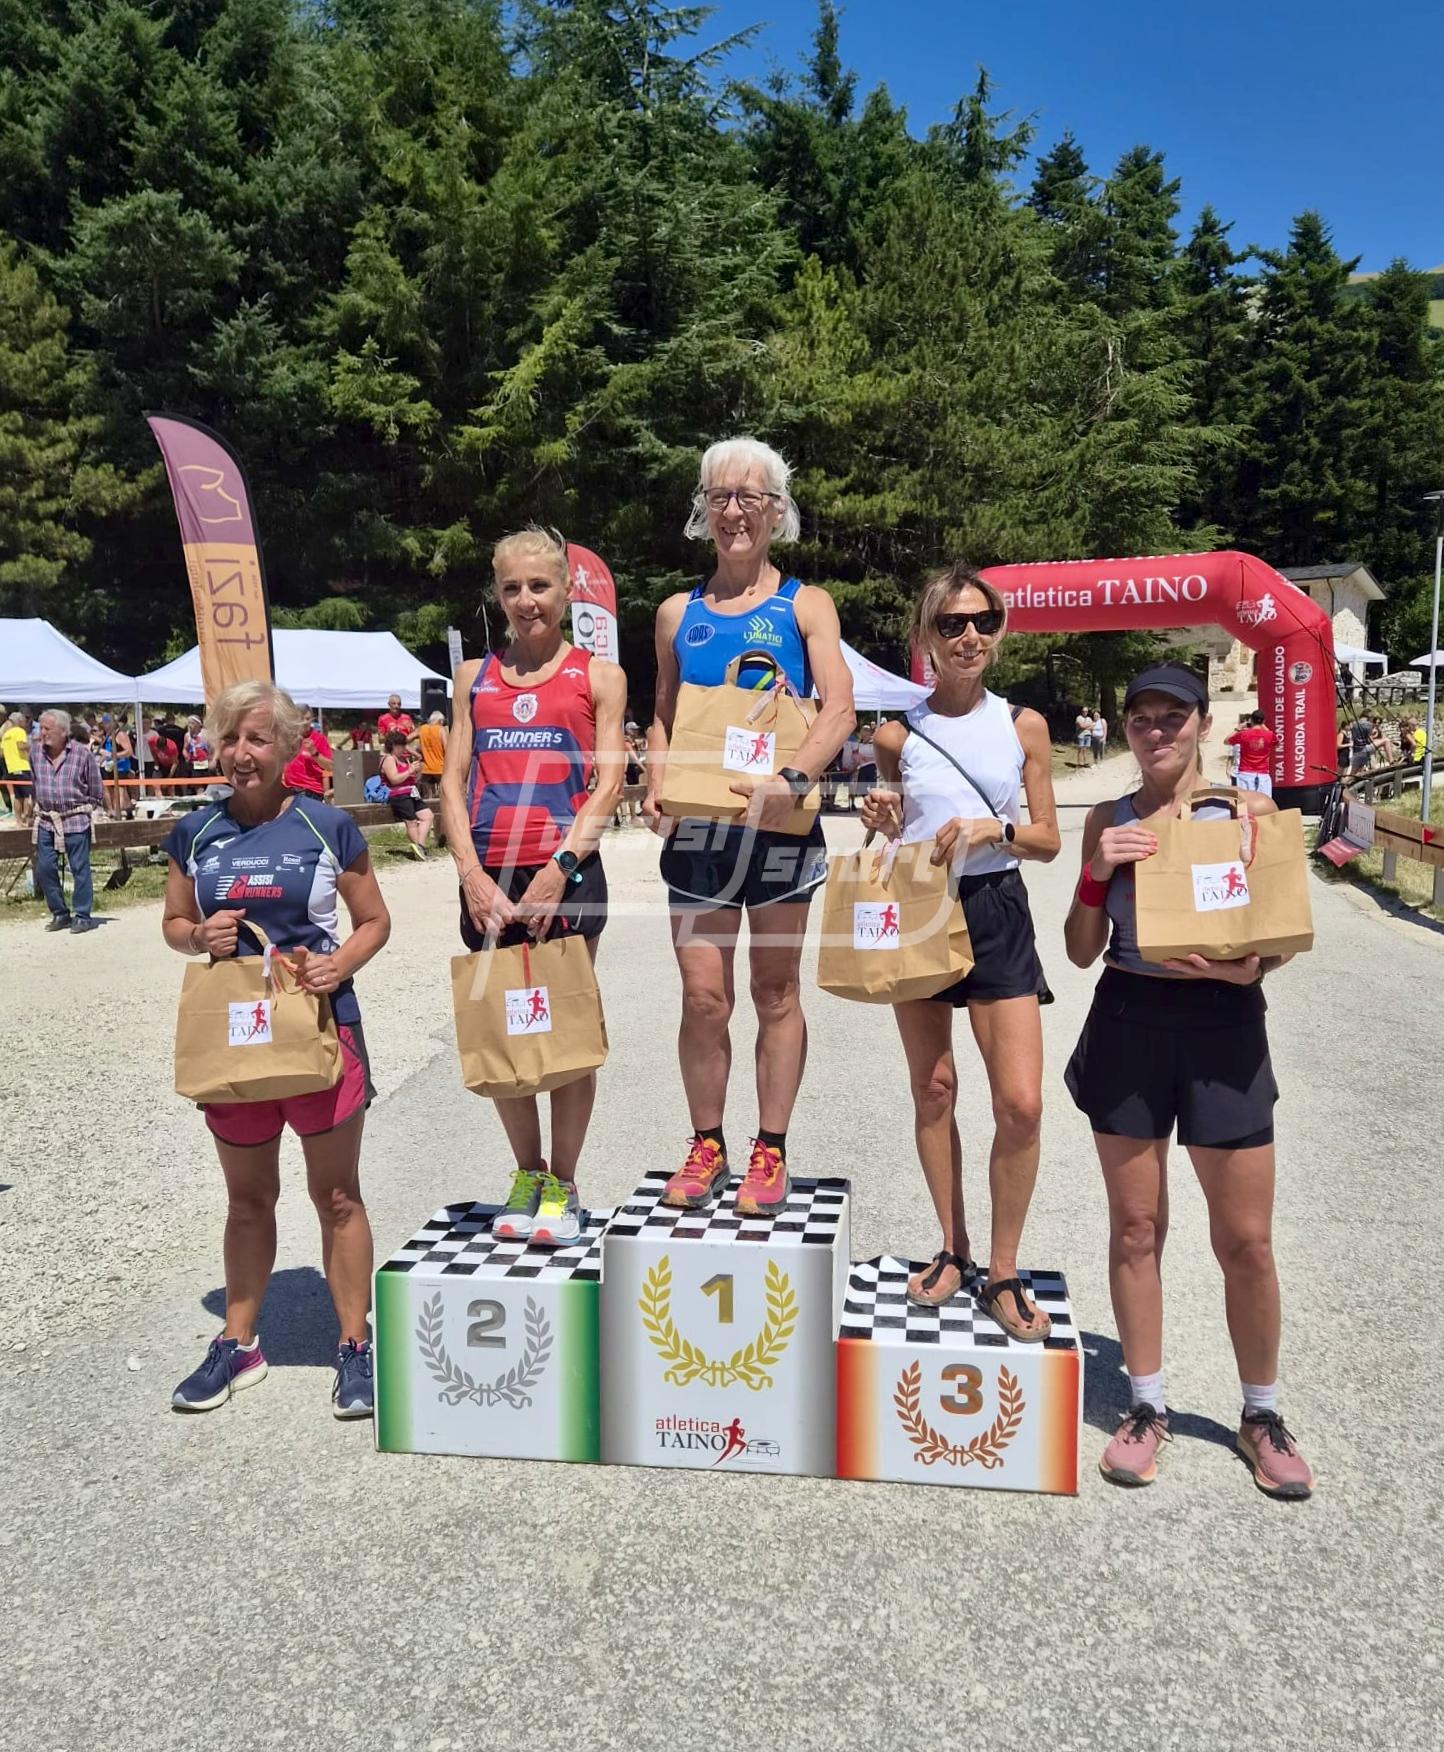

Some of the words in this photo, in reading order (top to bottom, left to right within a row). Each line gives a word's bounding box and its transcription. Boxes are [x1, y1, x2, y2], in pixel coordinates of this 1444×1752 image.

[1003, 583, 1092, 609] atletica
[1096, 574, 1208, 606] TAINO
[1274, 645, 1285, 694] GUALDO
[1275, 697, 1285, 713] DE
[1295, 688, 1306, 720] TRAIL
[1294, 723, 1306, 782] VALSORDA
[1274, 761, 1285, 783] TRA
[231, 859, 269, 867] VERDUCCI
[244, 886, 284, 898] RUNNERS
[247, 874, 275, 886] ASSISI
[699, 1273, 734, 1324] 1
[466, 1299, 507, 1349] 2
[939, 1363, 984, 1416] 3
[655, 1414, 720, 1433] atletica
[655, 1431, 727, 1451] TAINO
